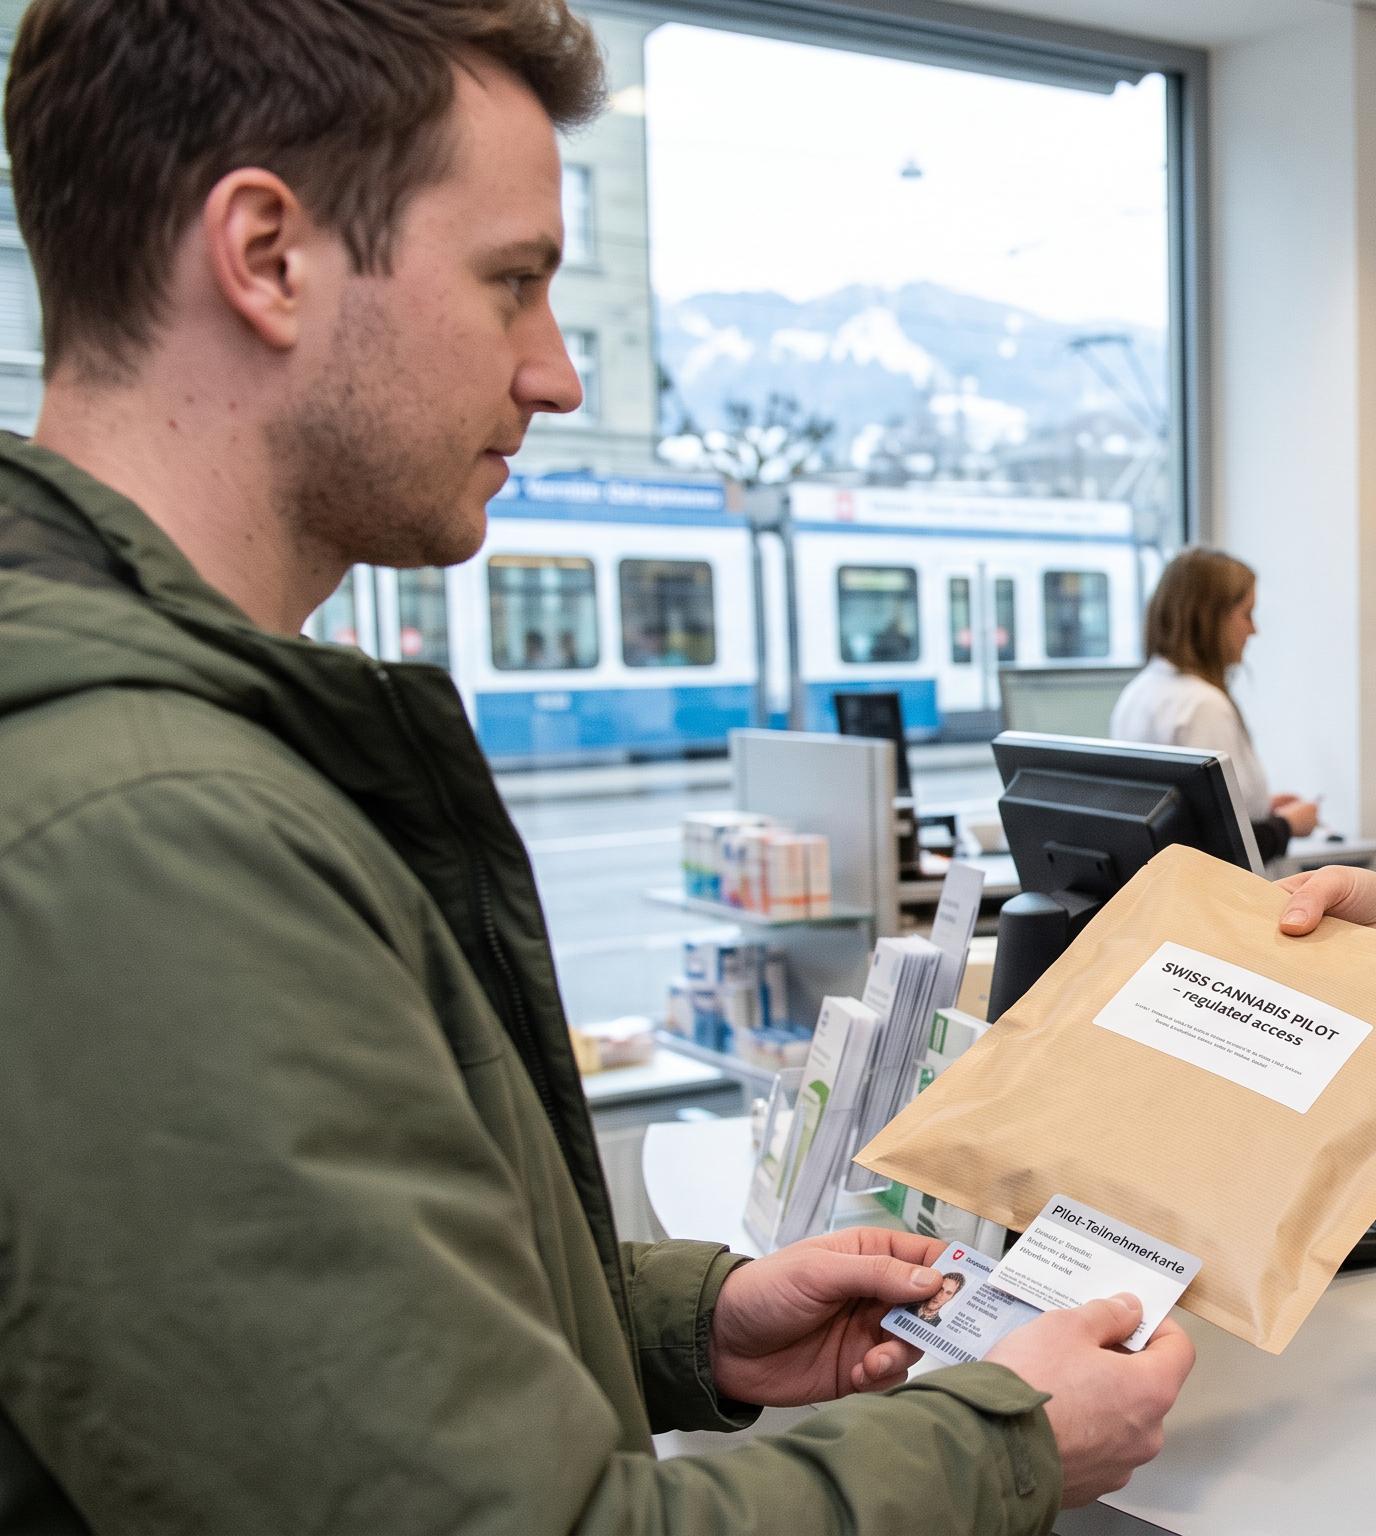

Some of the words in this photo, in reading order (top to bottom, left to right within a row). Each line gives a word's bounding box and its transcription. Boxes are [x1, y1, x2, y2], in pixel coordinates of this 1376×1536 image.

[1162, 962, 1211, 988] SWISS
[1211, 981, 1291, 1020] CANNABIS
[1291, 1015, 1340, 1042] PILOT
[1182, 990, 1251, 1024] regulated
[1251, 1020, 1304, 1046] access
[1051, 1205, 1185, 1275] Pilot-Teilnehmerkarte
